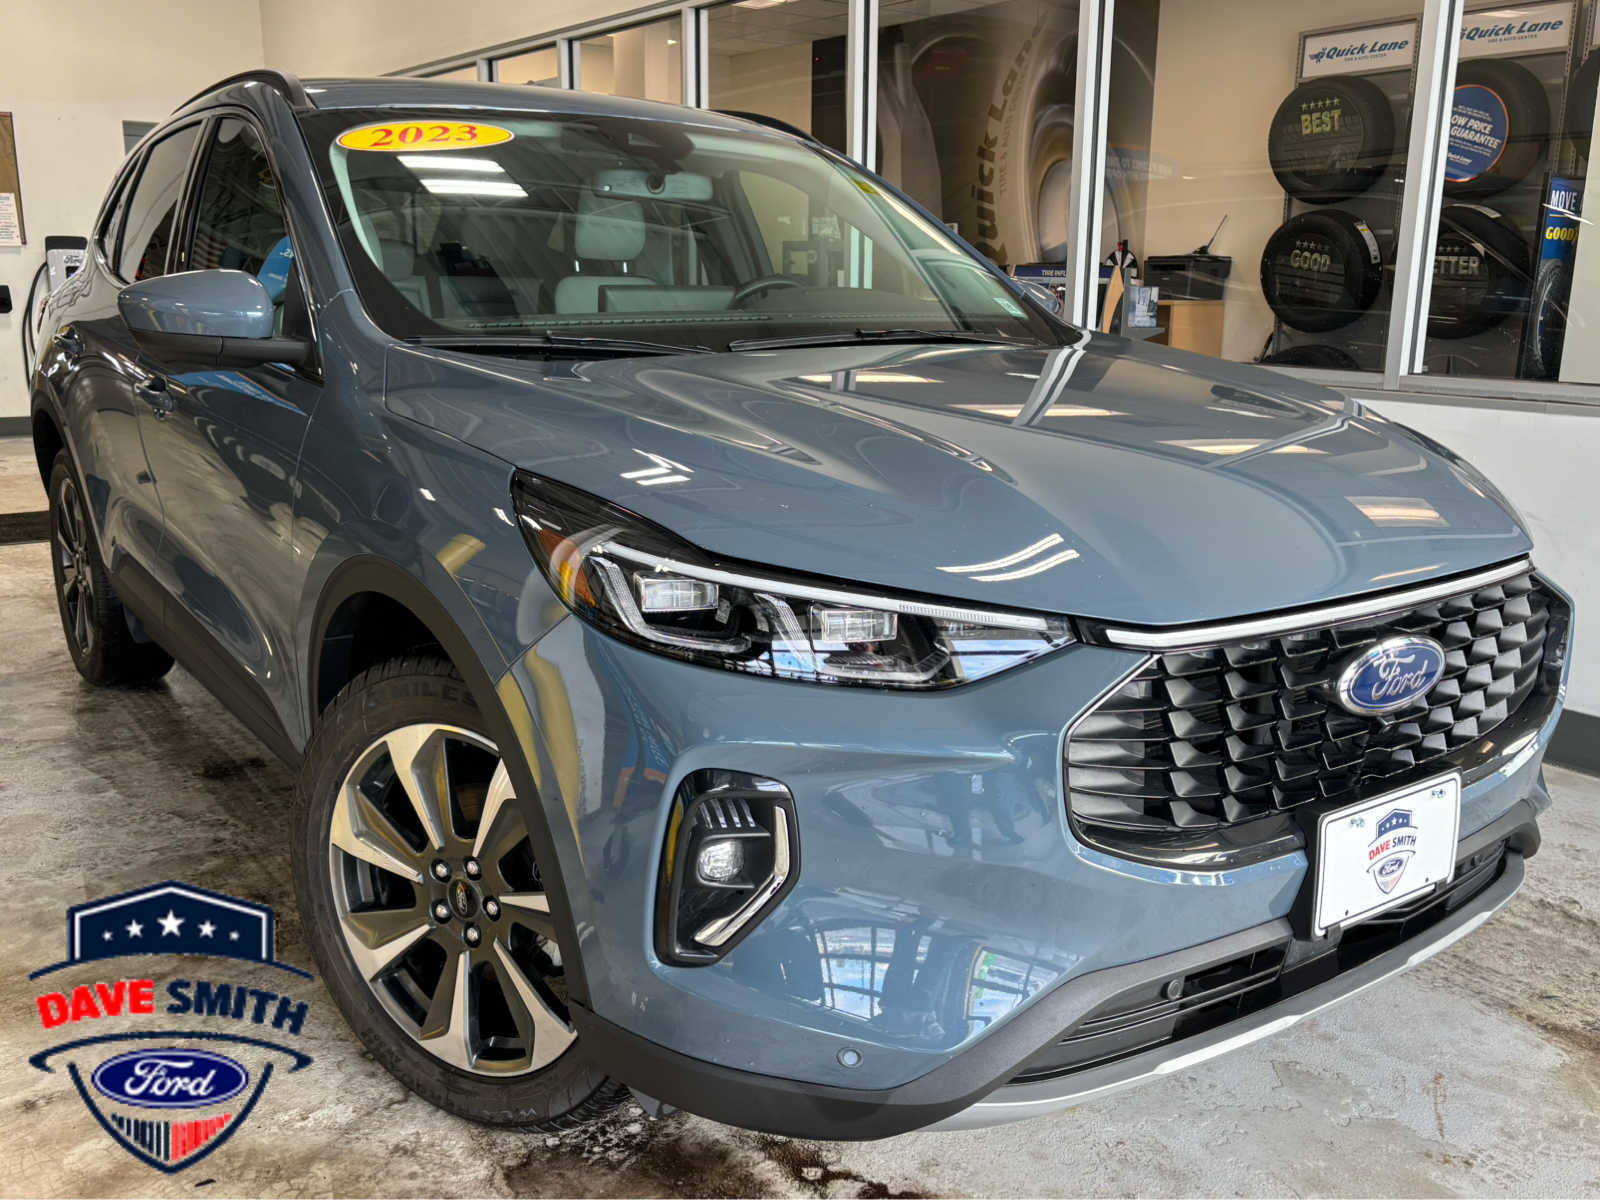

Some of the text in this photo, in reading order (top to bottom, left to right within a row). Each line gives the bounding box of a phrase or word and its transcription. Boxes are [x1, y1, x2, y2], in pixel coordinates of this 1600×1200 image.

[1465, 20, 1564, 40] Quick Lane
[1326, 43, 1368, 60] Quick
[1369, 40, 1409, 54] Lane
[1301, 109, 1342, 136] BEST
[1451, 114, 1494, 135] OW PRICE
[369, 125, 479, 148] 2023
[1450, 126, 1502, 149] GUARANTEE
[1550, 189, 1578, 210] MOVE
[1290, 249, 1331, 272] GOOD
[1433, 255, 1480, 275] ETTER
[1372, 652, 1429, 701] Ford
[1368, 835, 1417, 861] DAVE SMITH
